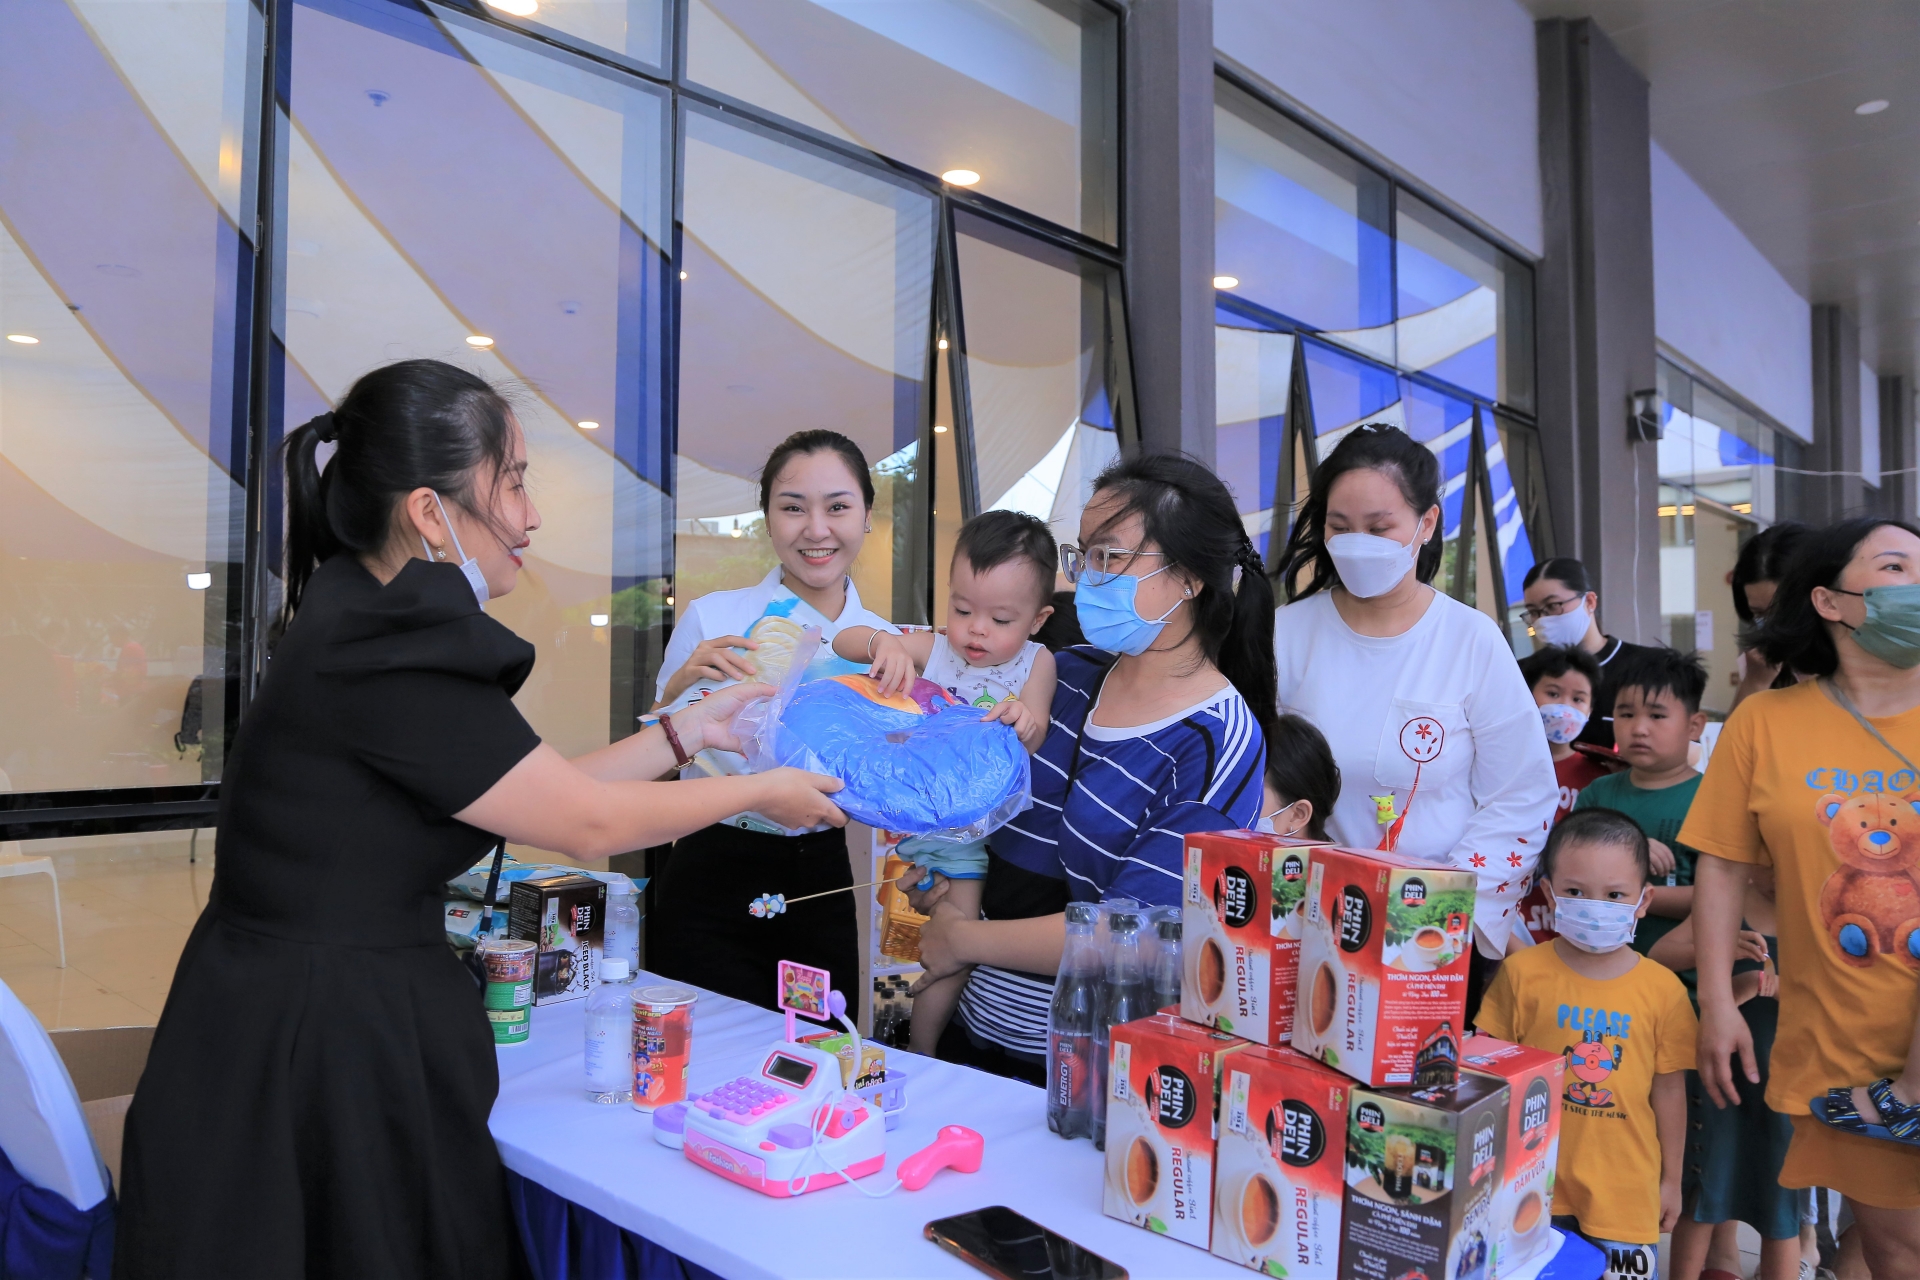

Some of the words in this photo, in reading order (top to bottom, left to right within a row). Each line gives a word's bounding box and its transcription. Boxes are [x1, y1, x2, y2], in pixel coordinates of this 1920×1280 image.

[1805, 768, 1920, 797] CHAO
[1284, 861, 1300, 869] PHIN
[1226, 876, 1236, 917] DELI
[1235, 877, 1247, 919] PHIN
[1405, 884, 1424, 892] PHIN
[576, 907, 584, 931] DELI
[1341, 895, 1354, 940] DELI
[1350, 898, 1363, 944] PHIN
[582, 962, 590, 991] BLACK
[1235, 946, 1248, 1017] REGULAR
[1347, 973, 1357, 1051] REGULAR
[1557, 1004, 1632, 1039] PLEASE
[1060, 1061, 1069, 1106] ENERGY
[1160, 1075, 1172, 1117] DELI
[1171, 1077, 1184, 1120] PHIN
[1360, 1107, 1381, 1118] PHIN
[1525, 1092, 1547, 1114] PHIN
[1570, 1106, 1588, 1116] STOP
[1282, 1109, 1297, 1154] DELI
[1296, 1113, 1312, 1159] PHIN
[1360, 1115, 1381, 1126] DELI
[1524, 1109, 1546, 1132] DELI
[1474, 1124, 1495, 1150] PHIN
[708, 1151, 734, 1172] Fashion
[1472, 1142, 1494, 1169] DELI
[1172, 1147, 1185, 1220] REGULAR
[1296, 1187, 1309, 1265] REGULAR
[1611, 1249, 1648, 1275] MO
